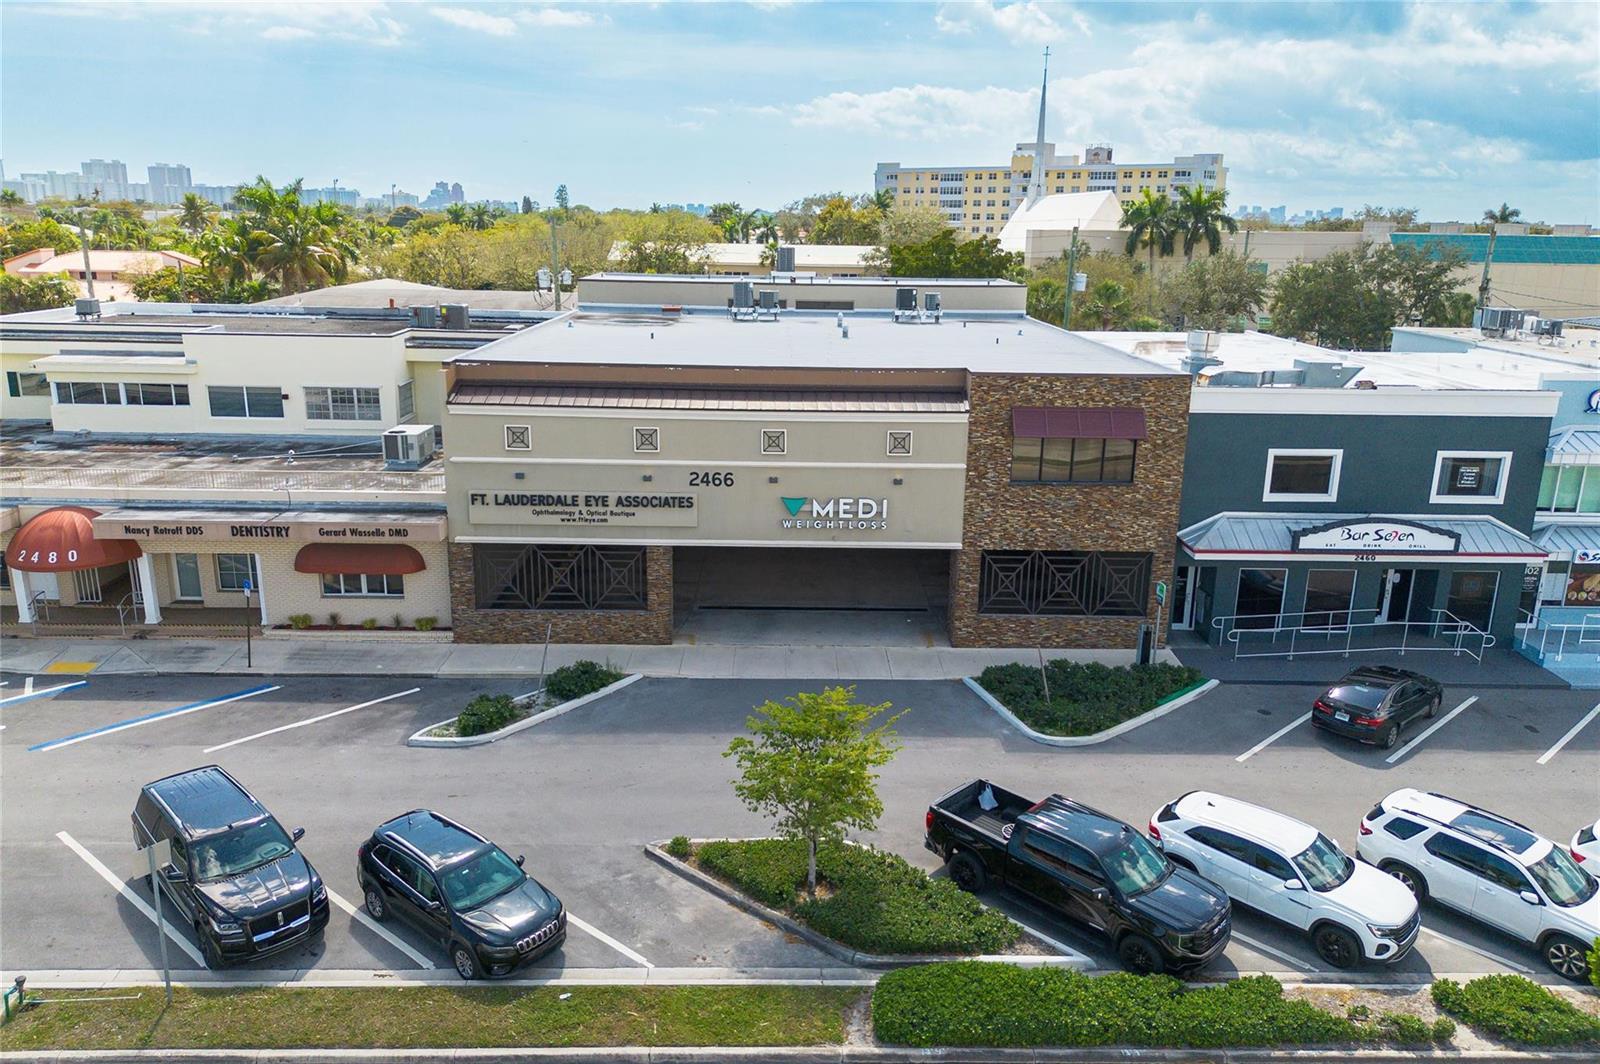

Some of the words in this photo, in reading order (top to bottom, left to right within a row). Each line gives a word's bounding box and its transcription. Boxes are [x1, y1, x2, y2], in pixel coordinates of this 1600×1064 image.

[688, 471, 735, 487] 2466
[470, 493, 490, 506] FT.
[494, 494, 580, 507] LAUDERDALE
[584, 495, 610, 507] EYE
[615, 496, 694, 508] ASSOCIATES
[531, 509, 576, 517] Ophthalmology
[586, 509, 608, 517] Optical
[811, 497, 888, 519] MEDI
[124, 525, 150, 537] Nancy
[153, 525, 183, 535] Rotroff
[186, 525, 204, 535] DDS
[230, 525, 291, 538] DENTISTRY
[782, 520, 888, 530] WEIGHTLOSS
[318, 527, 347, 537] Gerard
[350, 528, 386, 537] Wasselle
[388, 528, 409, 537] DMD
[1341, 528, 1370, 541] Bar
[17, 549, 78, 564] 2480
[1524, 567, 1540, 575] 102
